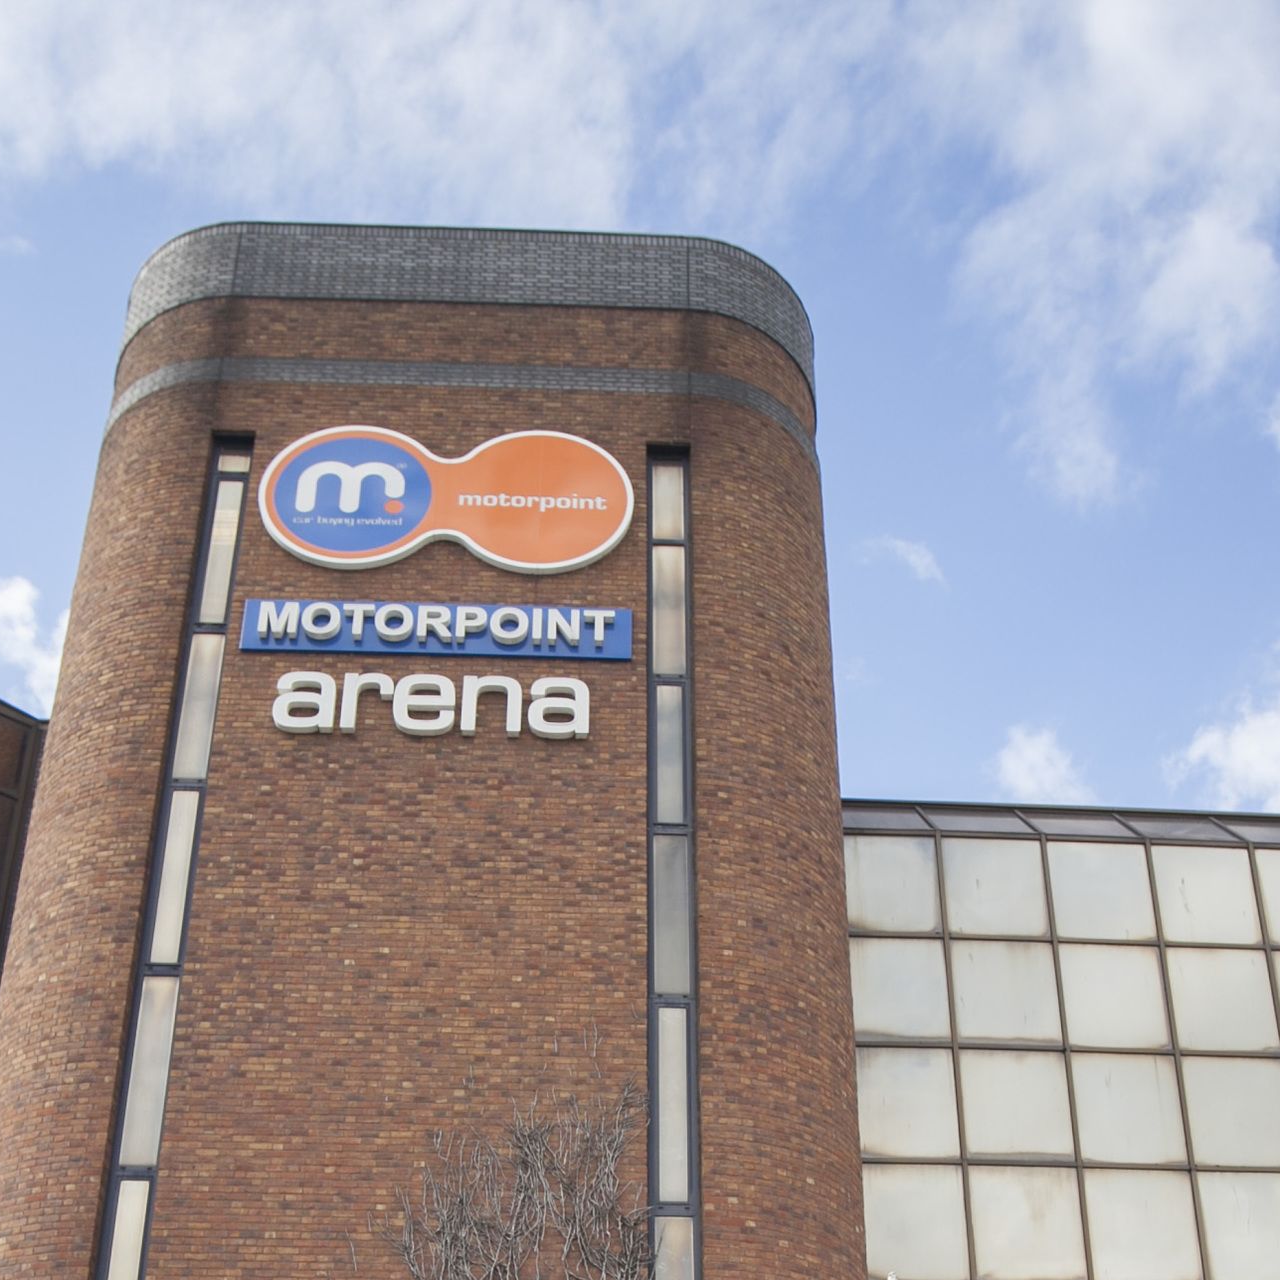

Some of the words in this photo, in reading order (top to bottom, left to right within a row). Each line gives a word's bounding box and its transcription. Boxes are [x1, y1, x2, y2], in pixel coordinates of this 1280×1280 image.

[458, 493, 608, 513] motorpoint
[317, 515, 354, 527] buying
[356, 516, 403, 526] evolved
[257, 601, 616, 648] MOTORPOINT
[272, 671, 590, 739] arena
